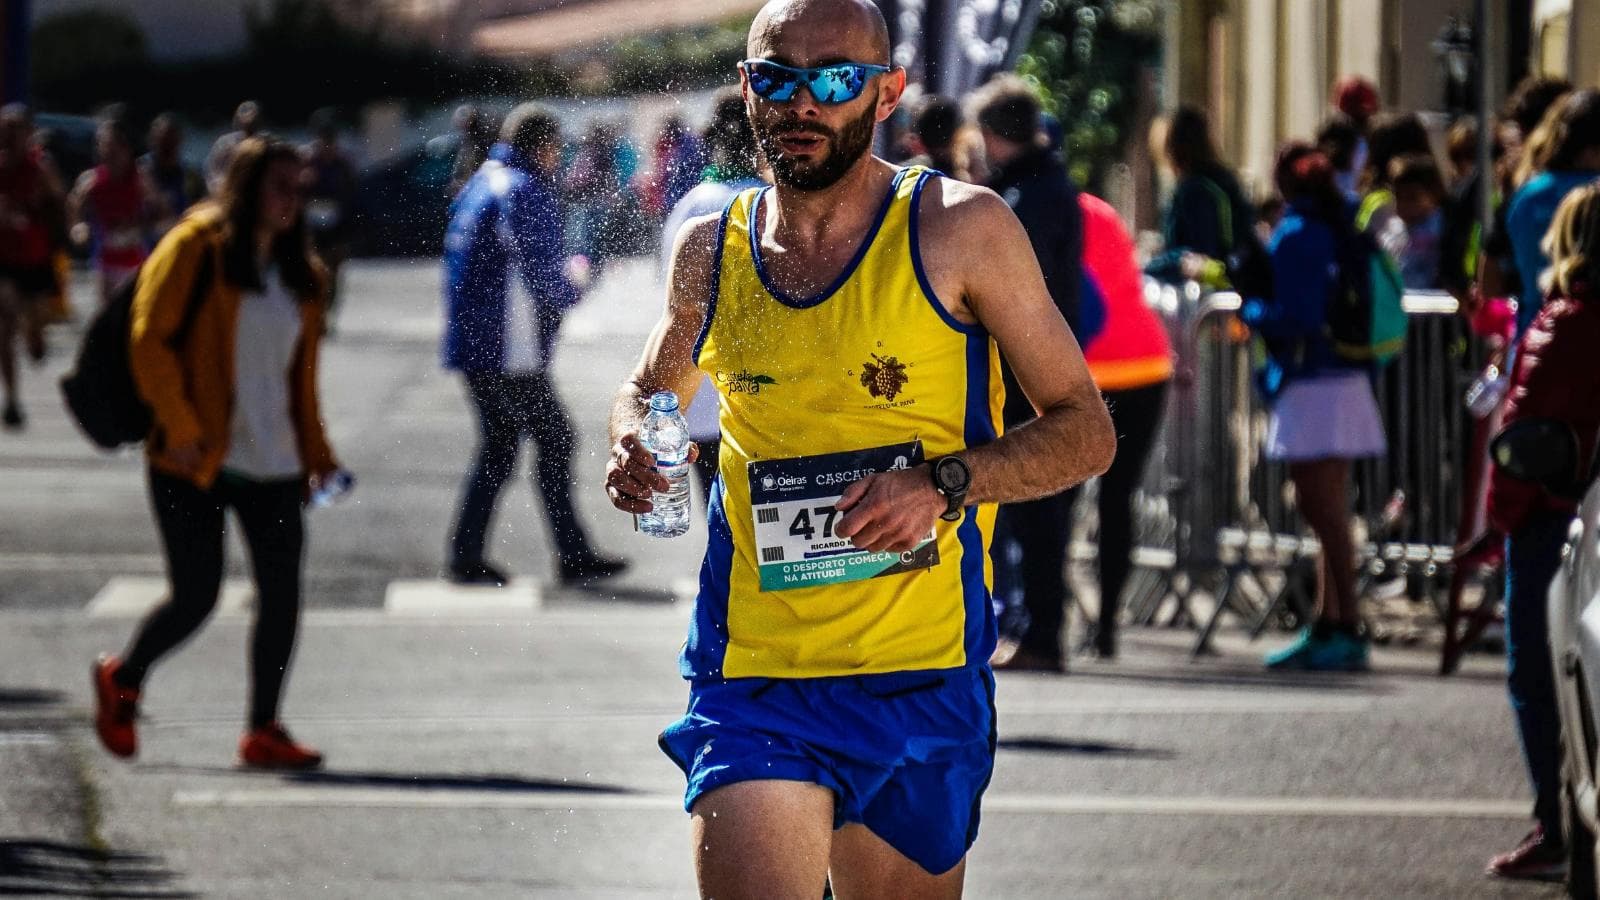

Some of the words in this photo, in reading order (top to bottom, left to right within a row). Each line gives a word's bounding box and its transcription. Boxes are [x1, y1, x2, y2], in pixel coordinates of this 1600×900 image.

[777, 475, 807, 486] Oeiras
[789, 505, 839, 540] 47
[811, 541, 846, 551] RICARDO
[783, 565, 790, 573] O
[793, 558, 846, 572] DESPORTO
[848, 552, 893, 565] COMEÇA
[784, 573, 799, 583] NA
[800, 567, 846, 581] ATITUDE!
